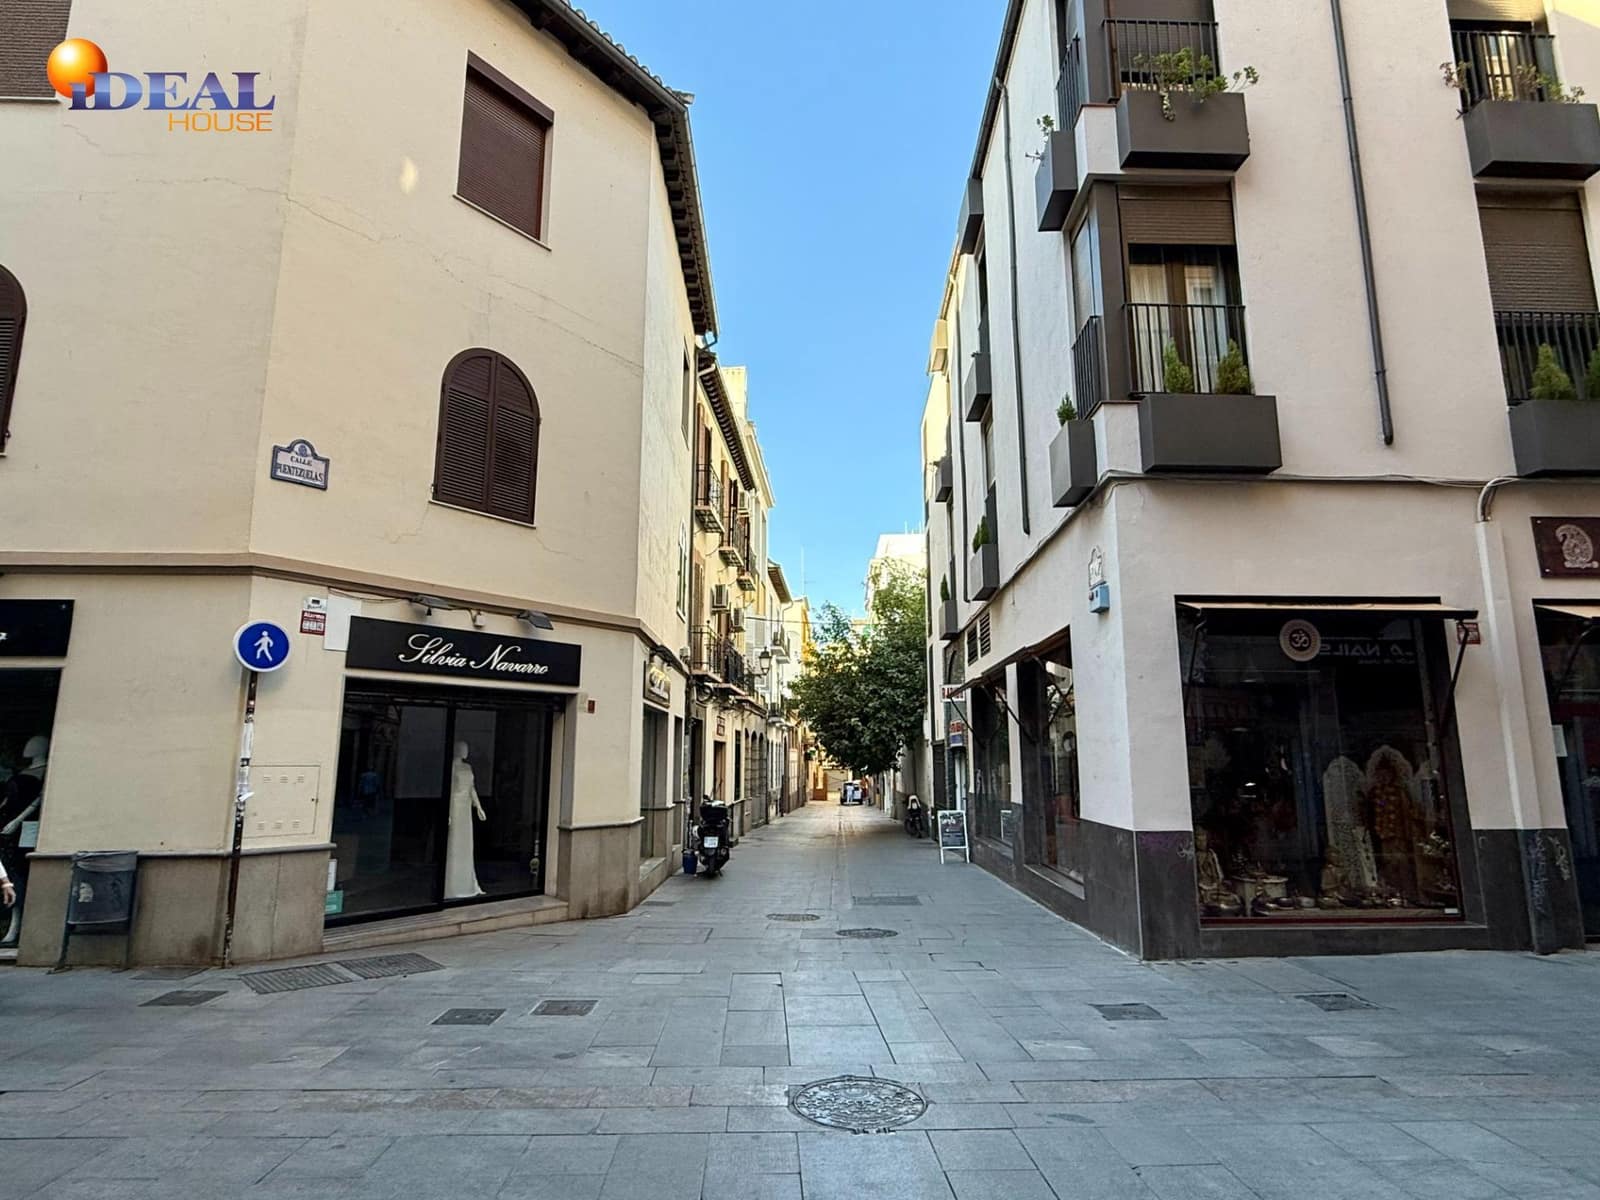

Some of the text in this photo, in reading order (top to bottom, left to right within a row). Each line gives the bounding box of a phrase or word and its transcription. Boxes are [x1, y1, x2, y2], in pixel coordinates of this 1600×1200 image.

[290, 455, 313, 466] CALLE
[398, 633, 550, 676] Silvia Navarro
